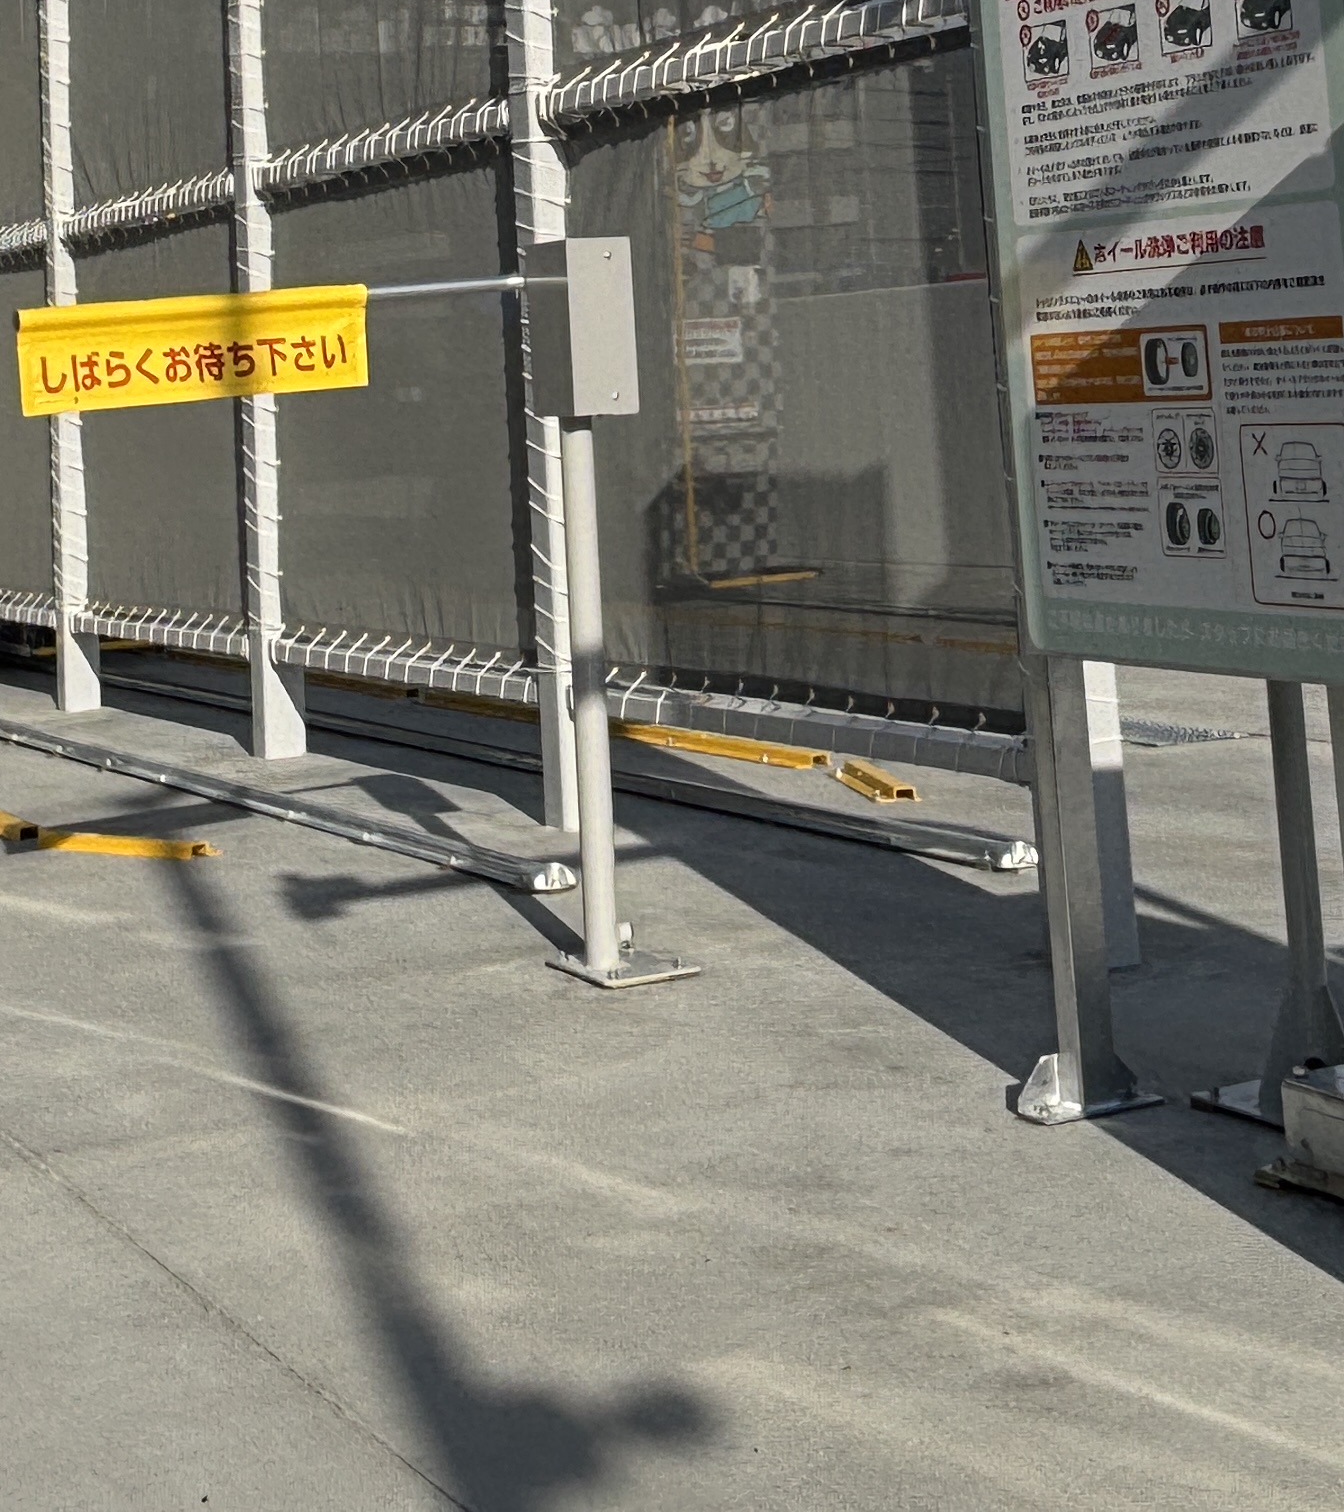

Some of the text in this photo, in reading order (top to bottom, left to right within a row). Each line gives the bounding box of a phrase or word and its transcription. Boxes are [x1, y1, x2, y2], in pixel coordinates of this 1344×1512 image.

[40, 335, 348, 394] しばらくお待ち下さい
